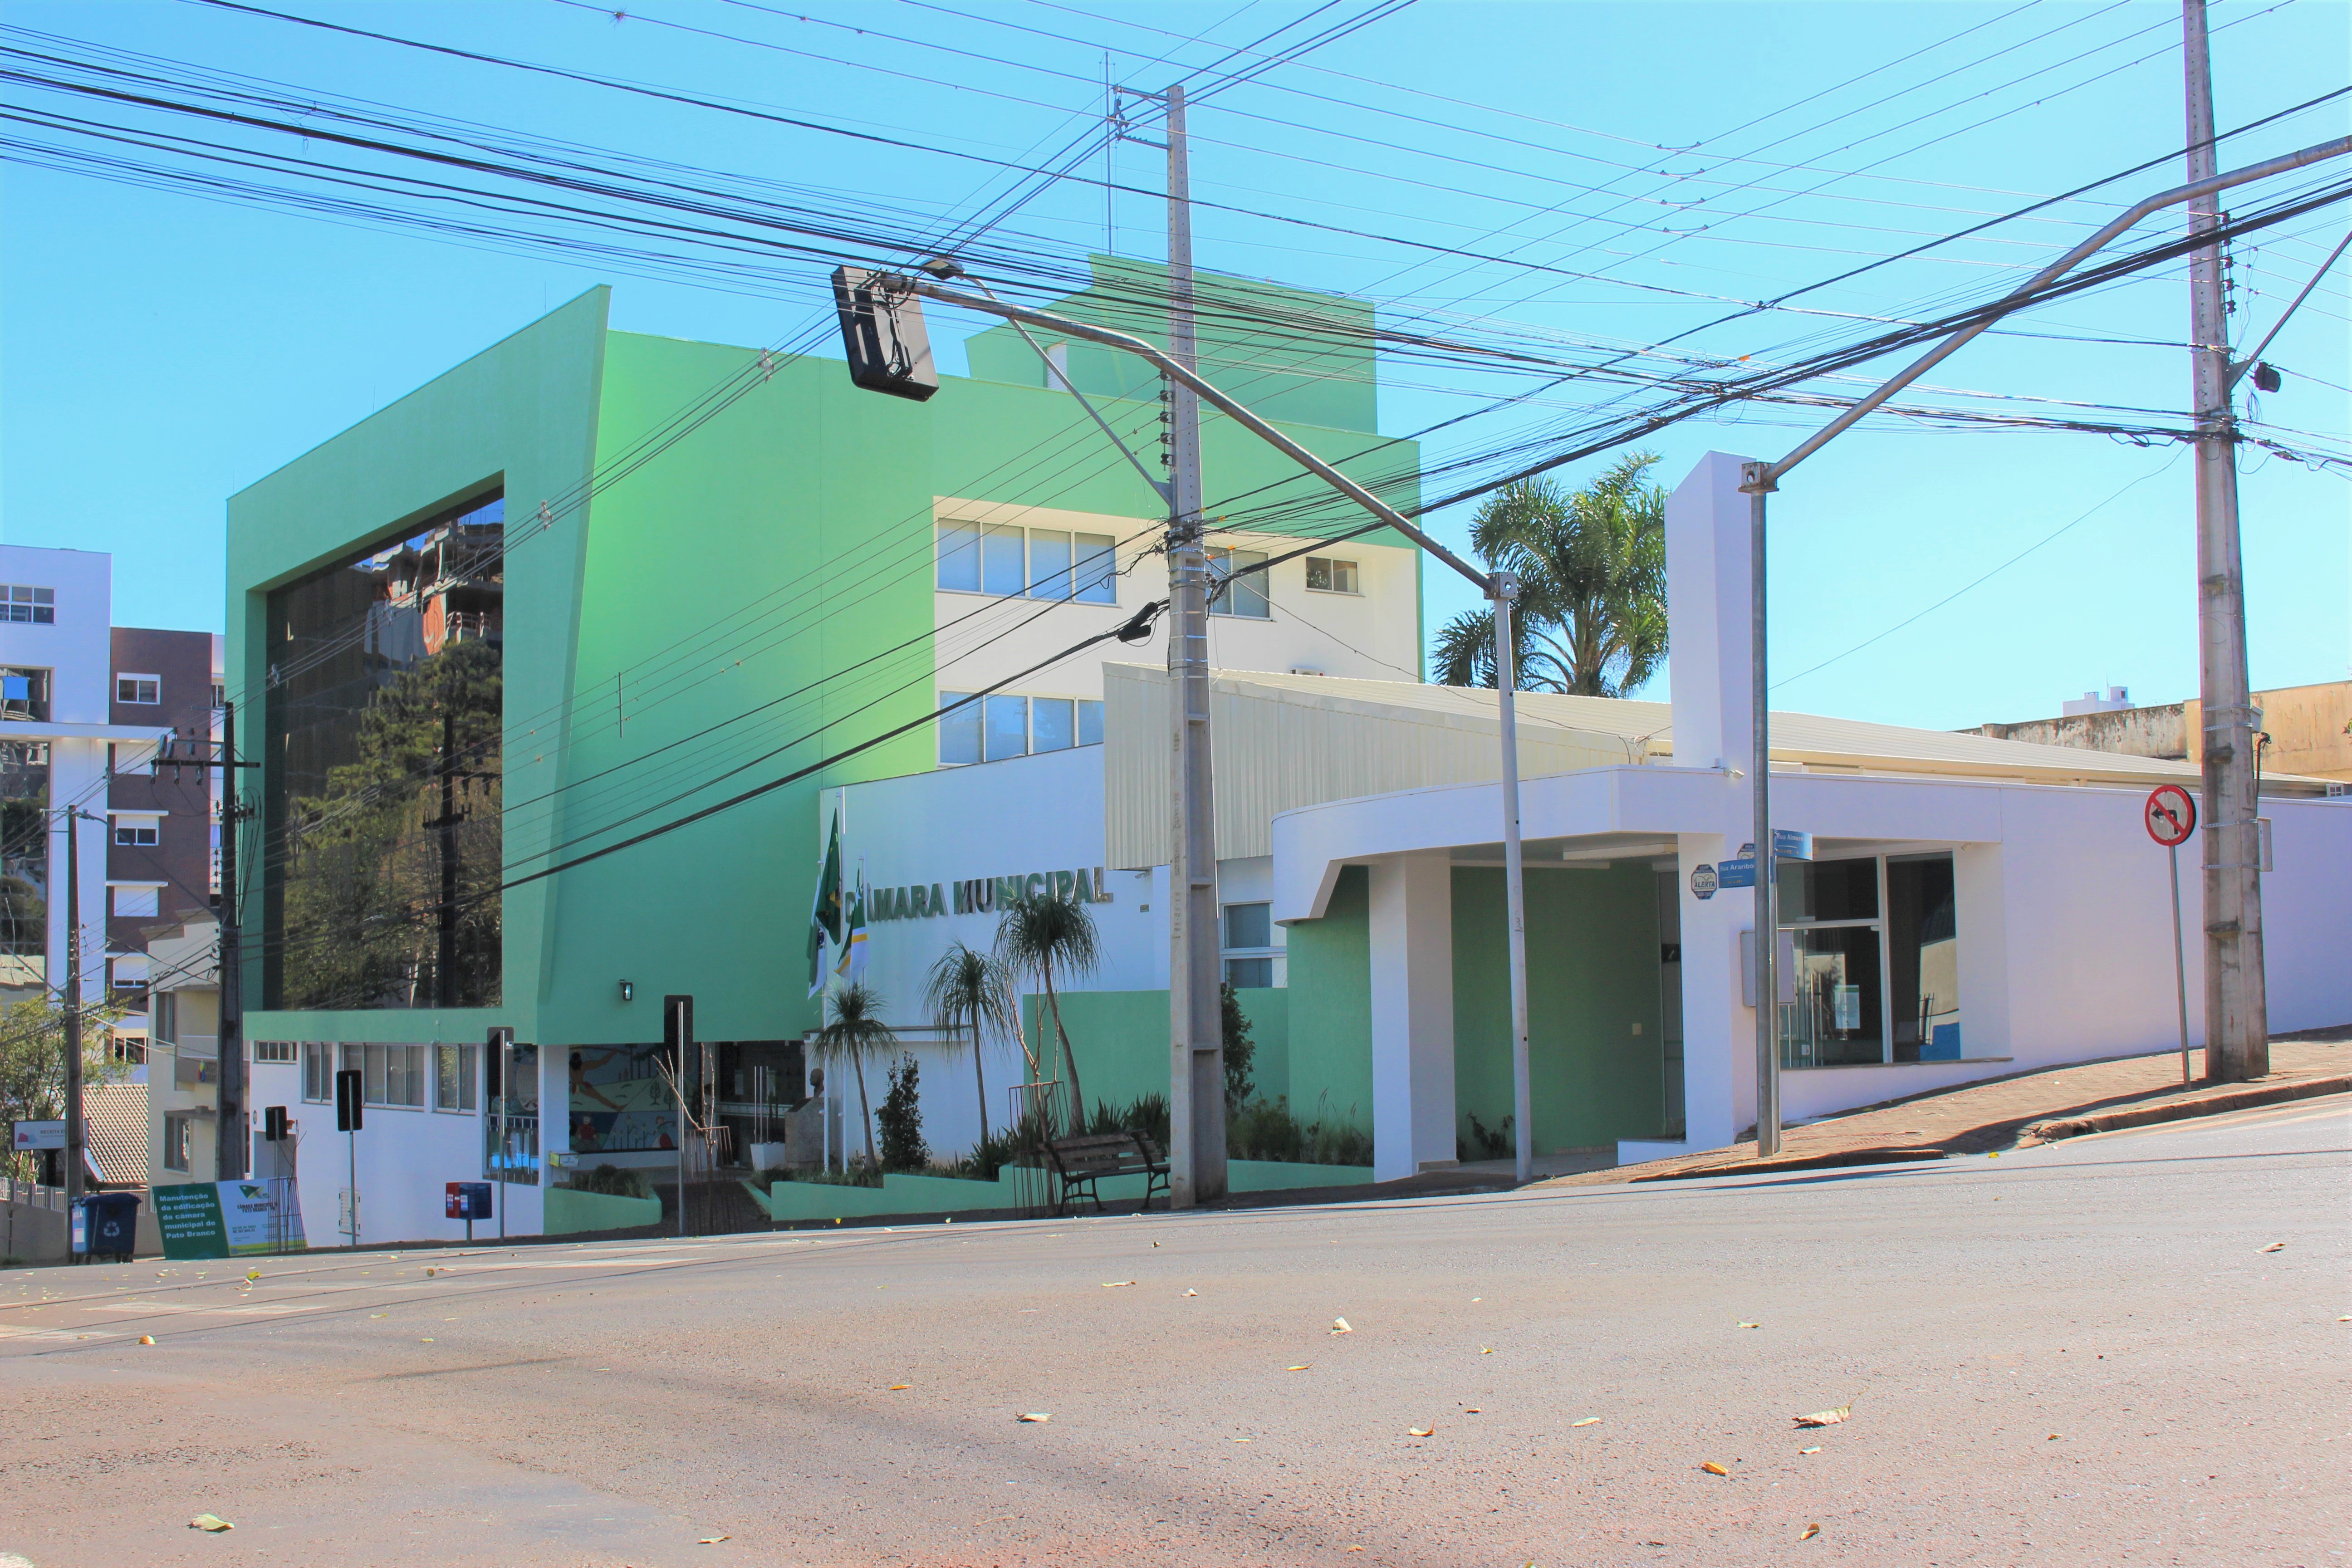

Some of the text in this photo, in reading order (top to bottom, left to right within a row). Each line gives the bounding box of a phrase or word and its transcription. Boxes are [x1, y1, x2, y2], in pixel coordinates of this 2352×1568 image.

[953, 867, 1113, 915] MUNICIPAL
[160, 1193, 209, 1202] Manutenção
[173, 1202, 215, 1210] edificação
[164, 1221, 204, 1230] municipal
[186, 1230, 216, 1238] Branco
